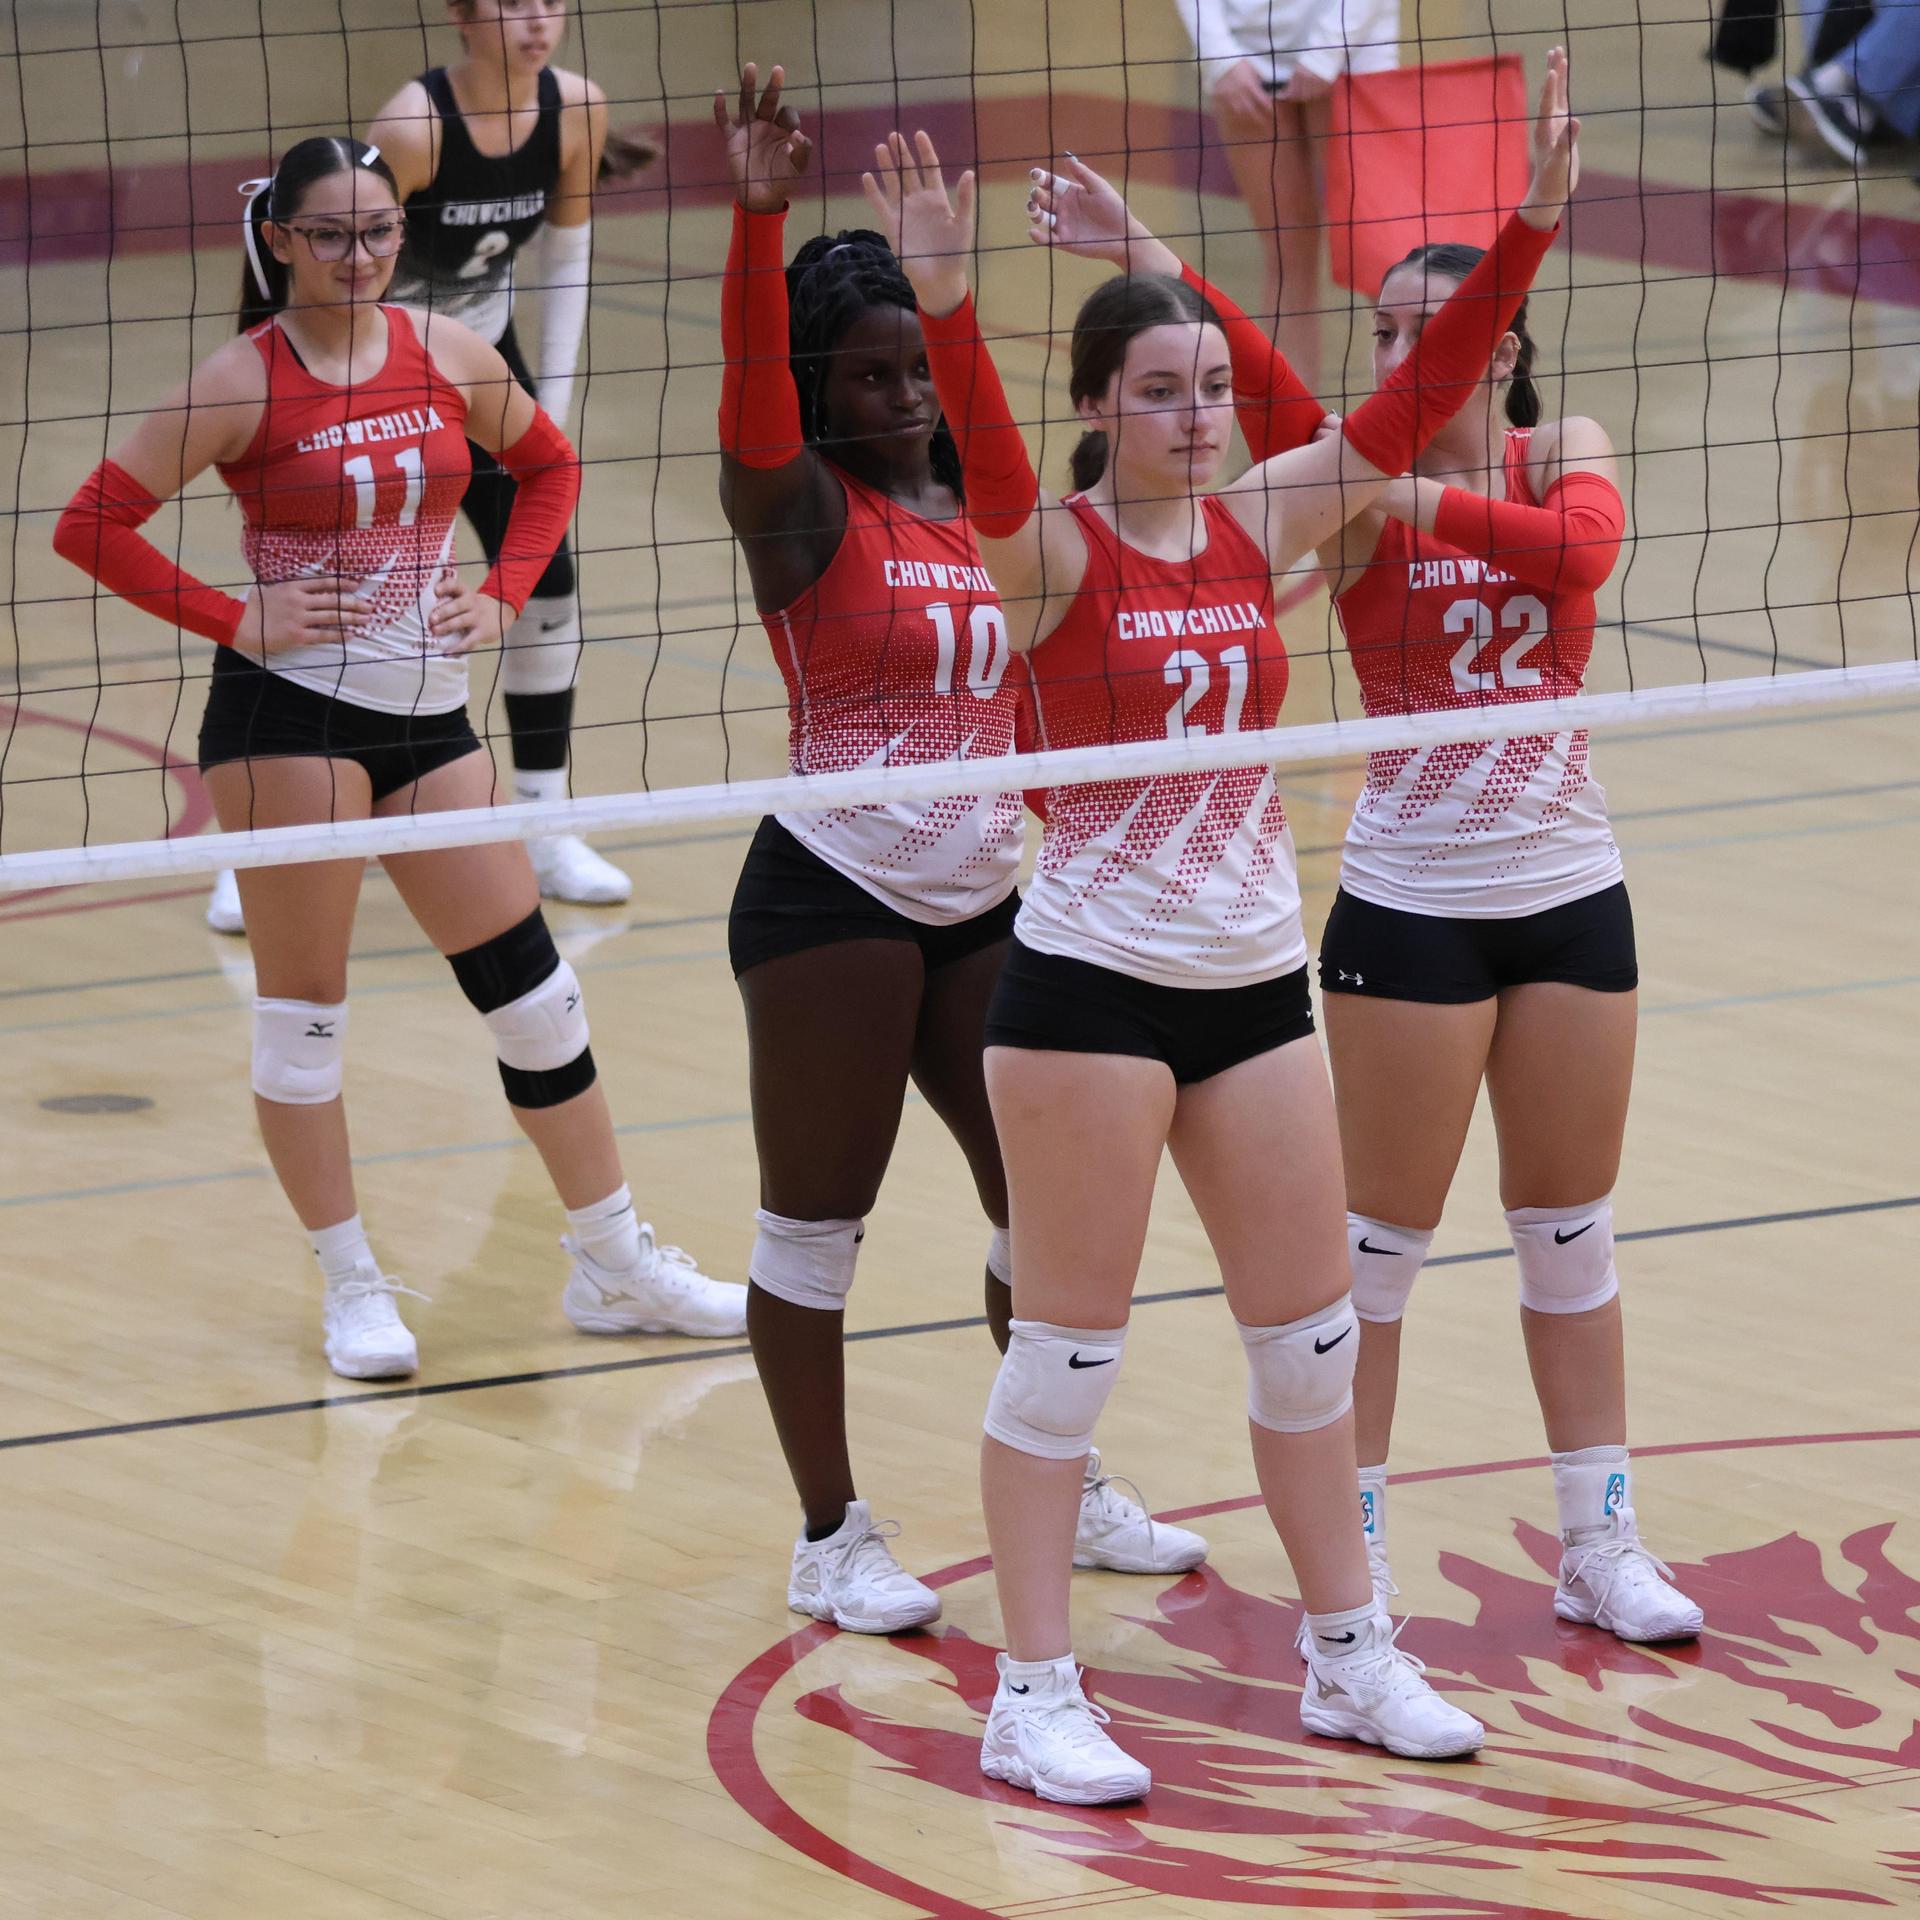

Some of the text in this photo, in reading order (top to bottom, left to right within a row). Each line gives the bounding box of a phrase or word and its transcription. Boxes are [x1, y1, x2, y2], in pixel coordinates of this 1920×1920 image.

[457, 231, 509, 279] 2
[344, 447, 426, 529] 11
[925, 602, 1010, 699] 10
[1117, 603, 1267, 640] CHOWCHILLA
[1443, 594, 1548, 693] 22
[1164, 645, 1248, 738] 21
